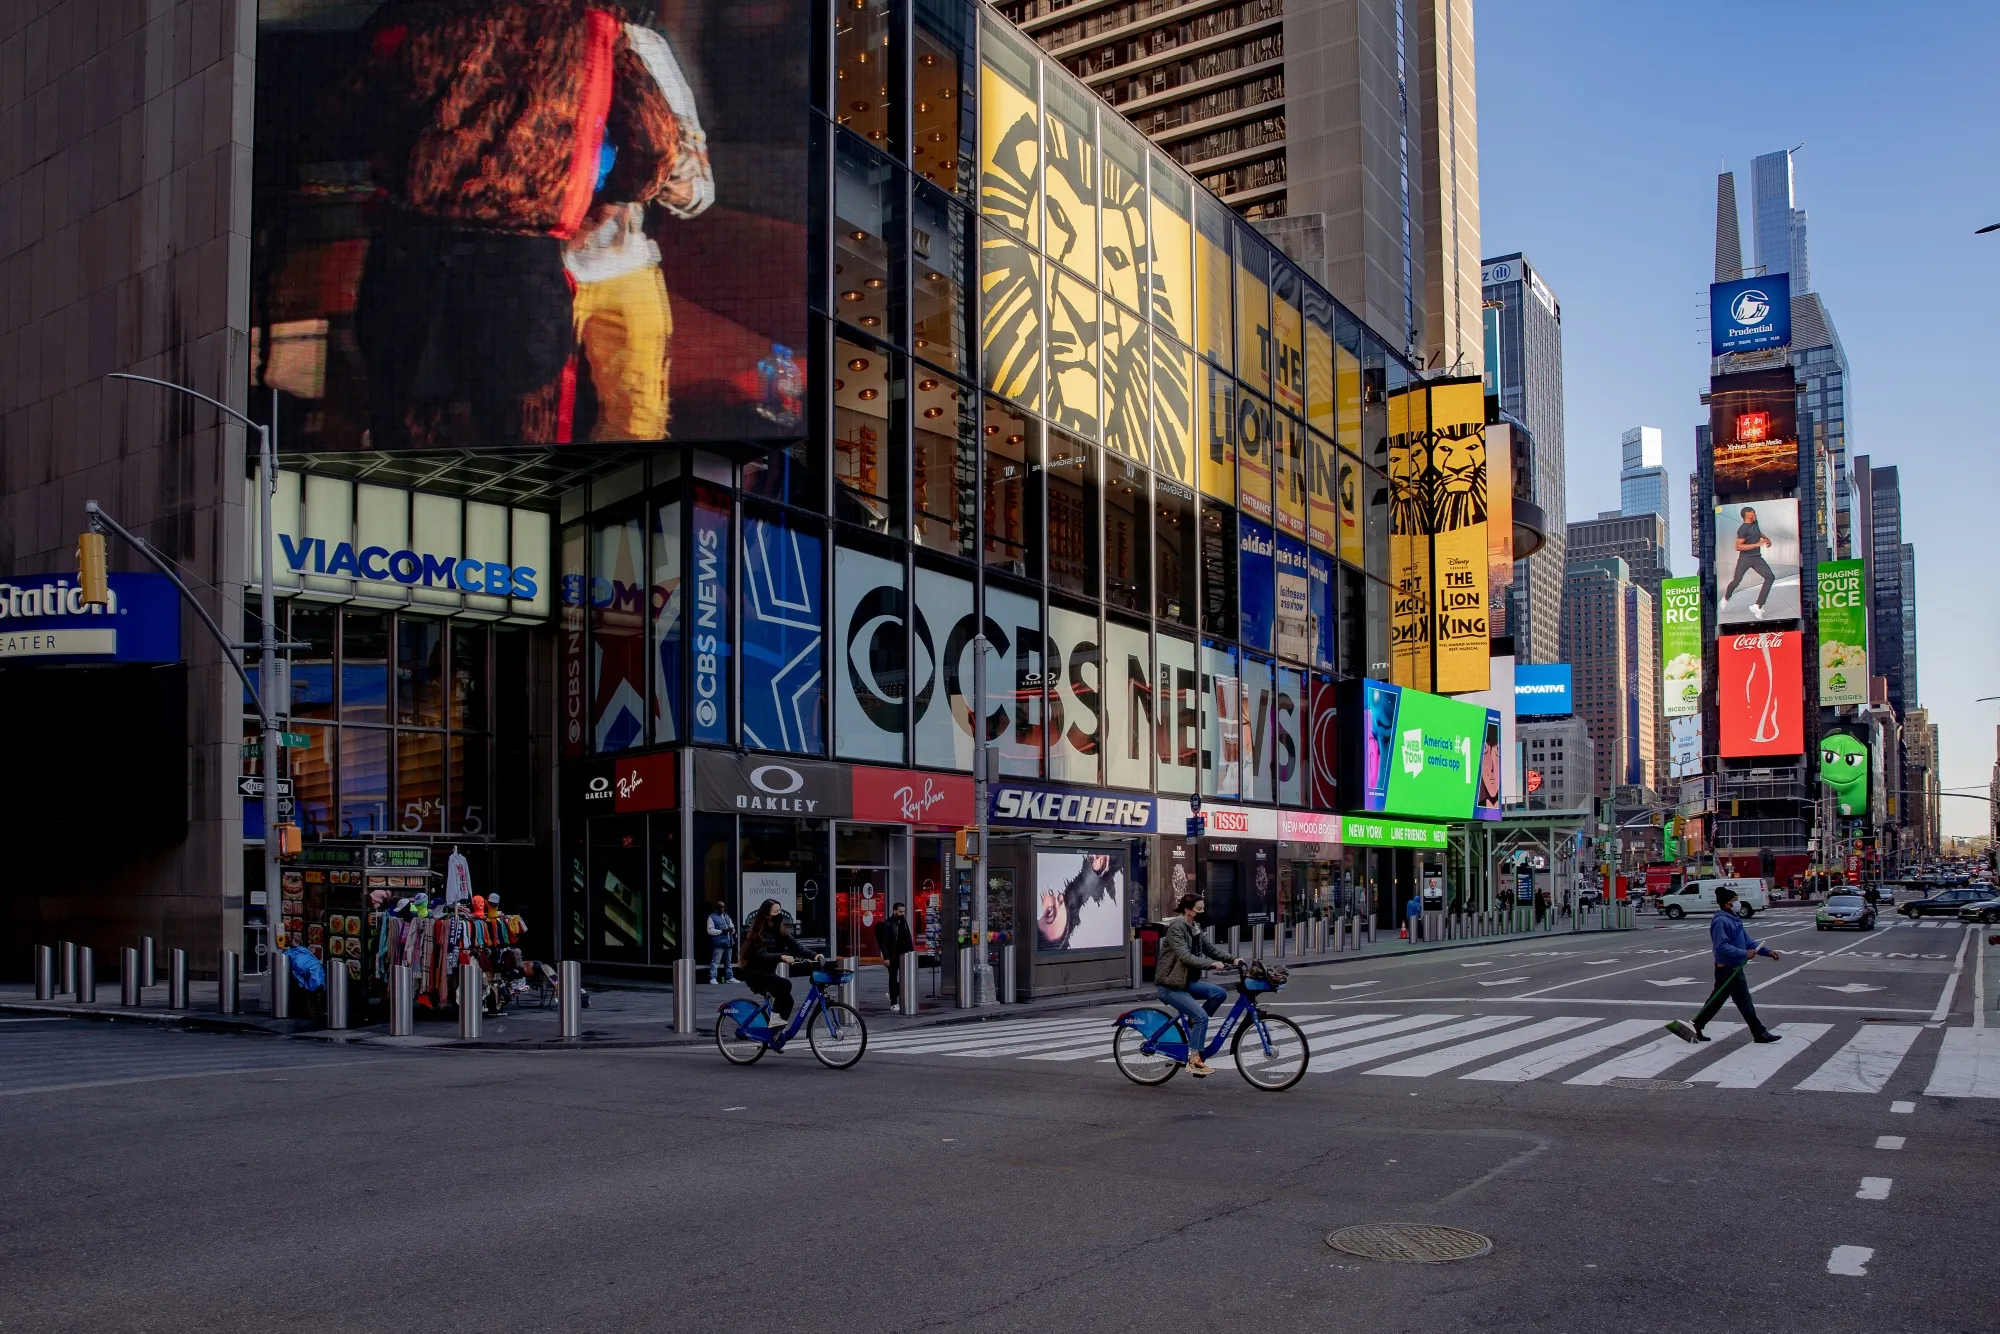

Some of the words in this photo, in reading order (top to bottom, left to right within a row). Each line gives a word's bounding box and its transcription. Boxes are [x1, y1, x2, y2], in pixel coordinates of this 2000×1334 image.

[1728, 323, 1773, 337] Prudential
[1257, 323, 1302, 395] THE
[1765, 438, 1782, 446] Media
[1242, 493, 1271, 515] ENTRANCE
[1278, 511, 1287, 524] ON
[1290, 518, 1303, 532] 45TH
[1310, 528, 1326, 543] STREET
[278, 533, 538, 599] VIACOMCBS
[1447, 557, 1470, 566] Disney
[697, 527, 718, 629] NEWS
[1445, 571, 1473, 586] THE
[1441, 589, 1480, 612] LION
[1438, 613, 1486, 641] KING
[697, 633, 717, 698] CBS
[568, 659, 581, 719] CBS
[943, 612, 1110, 756] CBS
[1515, 684, 1565, 694] NOVATIVE
[1834, 693, 1863, 701] VEGGIES
[1667, 705, 1686, 713] RICED
[289, 735, 294, 745] 7
[1405, 739, 1420, 751] WEB
[251, 746, 258, 756] 44
[1404, 751, 1422, 764] TOON
[1424, 734, 1453, 750] America's
[1454, 735, 1471, 784] #1
[1428, 754, 1448, 767] comics
[1449, 759, 1460, 771] app
[246, 783, 262, 791] ONE
[585, 790, 614, 800] OAKLEY
[737, 795, 817, 813] OAKLEY
[994, 788, 1152, 827] SKECHERS
[1211, 812, 1249, 832] TISSOT
[1348, 824, 1365, 838] NEW
[1365, 825, 1383, 839] YORK
[1390, 827, 1402, 840] LINE
[1403, 828, 1427, 842] FRIENDS
[1433, 830, 1447, 843] NEW
[388, 850, 404, 858] TIMES
[404, 850, 425, 860] SQUARE
[1219, 844, 1238, 853] TISSOT
